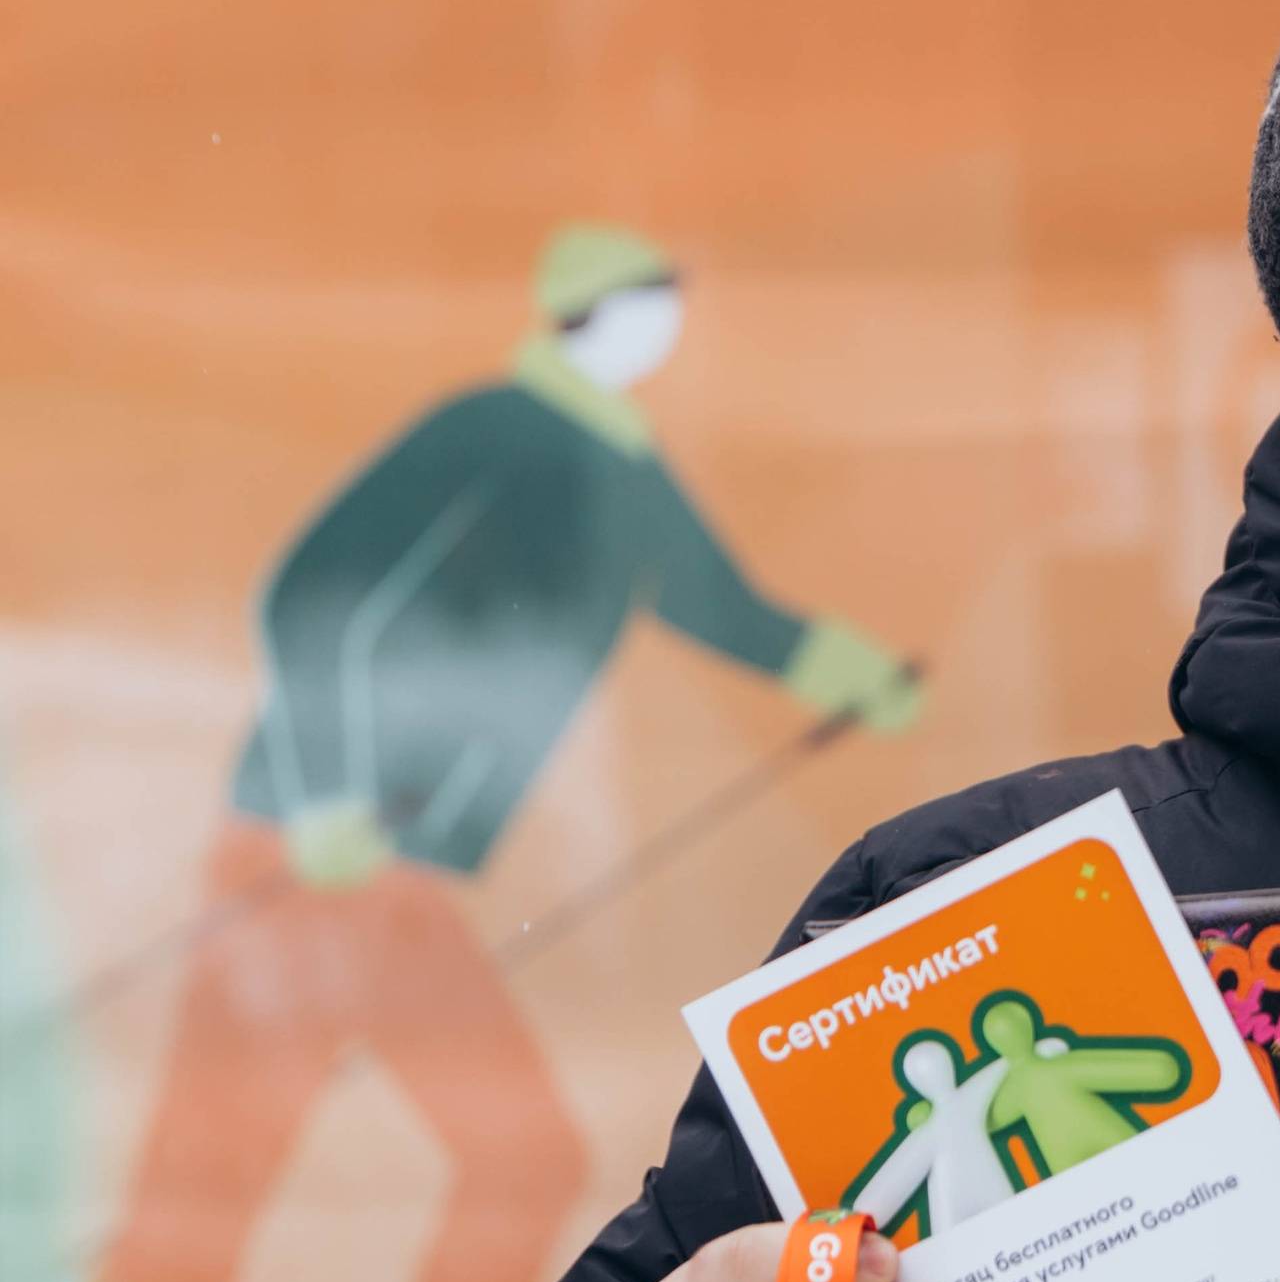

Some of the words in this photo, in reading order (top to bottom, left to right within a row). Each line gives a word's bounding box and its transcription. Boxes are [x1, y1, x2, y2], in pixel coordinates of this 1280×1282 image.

[757, 923, 999, 1062] Сертификат
[993, 1195, 1135, 1272] бесплатного
[1140, 1173, 1239, 1230] Goodline
